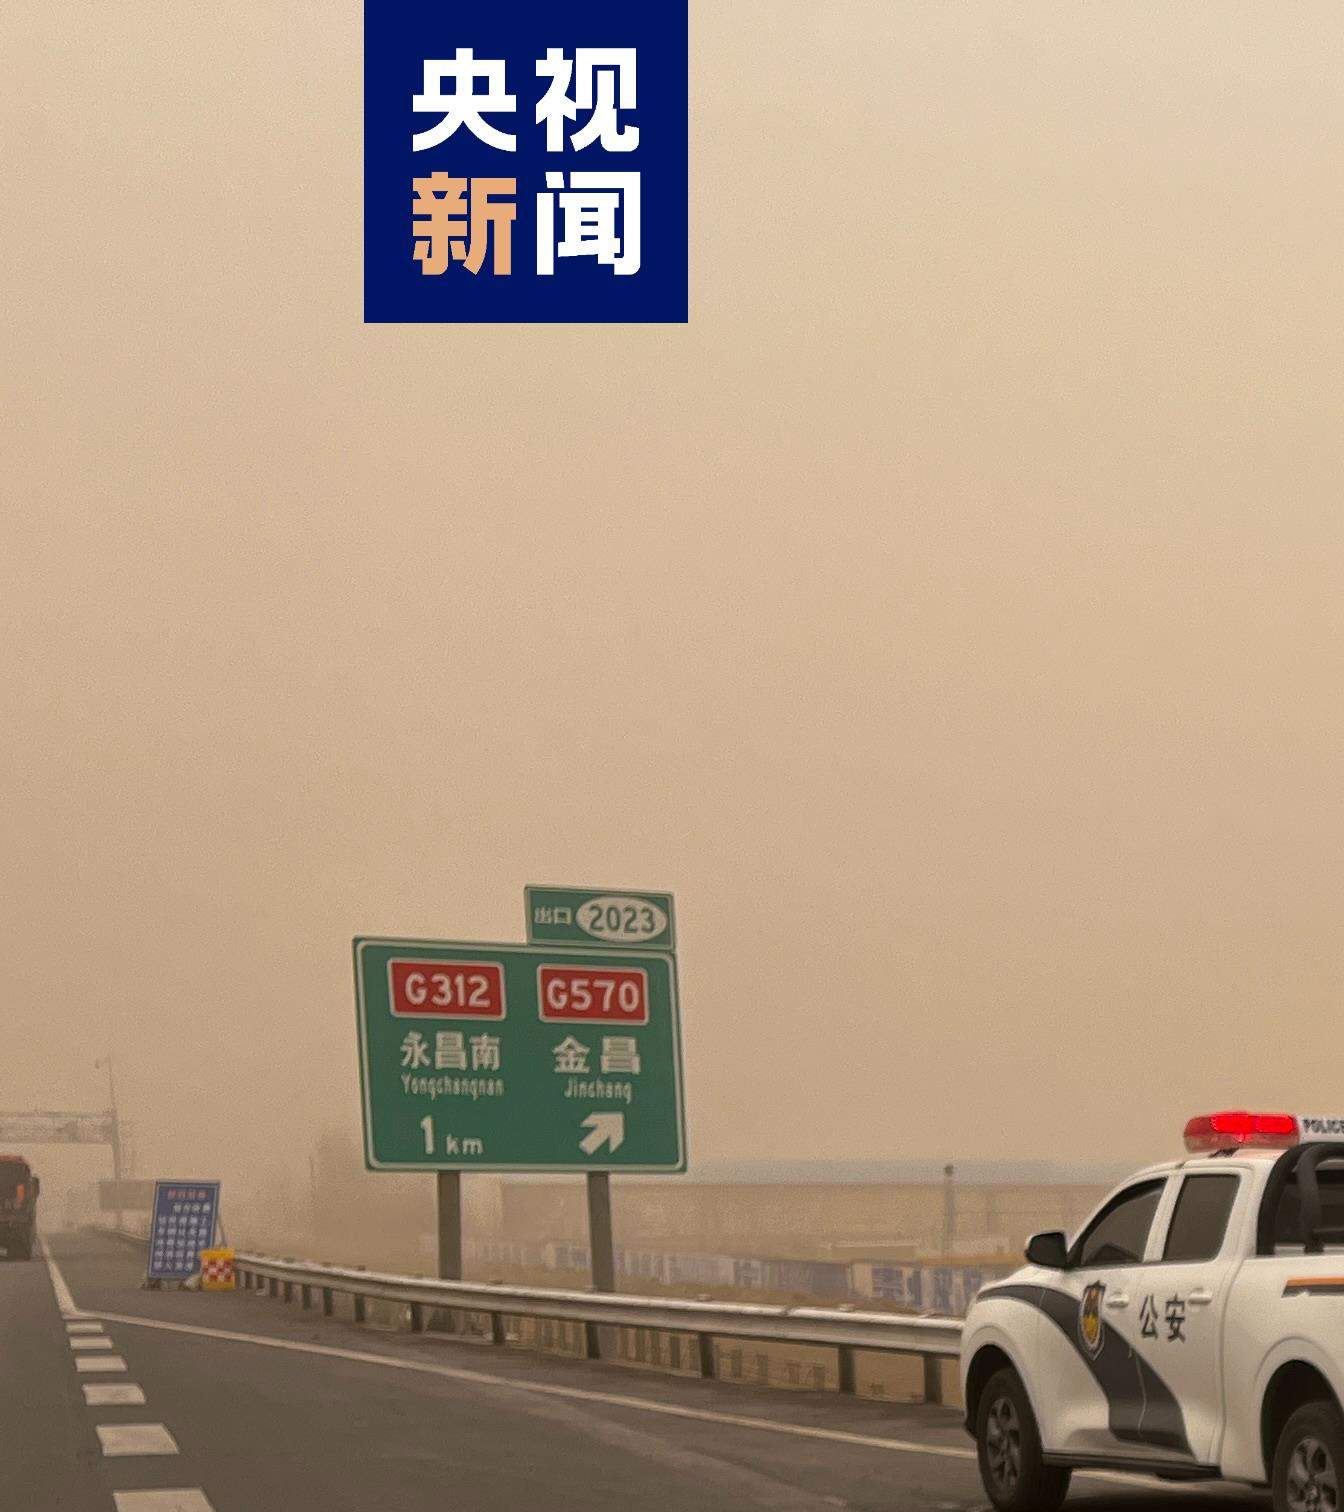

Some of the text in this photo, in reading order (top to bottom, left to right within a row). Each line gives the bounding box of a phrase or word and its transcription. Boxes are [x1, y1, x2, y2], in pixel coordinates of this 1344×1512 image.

[534, 903, 657, 934] 出口 2023
[404, 971, 492, 1009] G312
[546, 977, 640, 1013] G570
[400, 1030, 502, 1071] 永昌南
[552, 1034, 641, 1075] 金昌
[400, 1072, 504, 1101] Yongchangnan
[563, 1077, 632, 1104] Jinchang
[420, 1115, 485, 1156] 1 km
[1139, 1293, 1186, 1343] 公安
